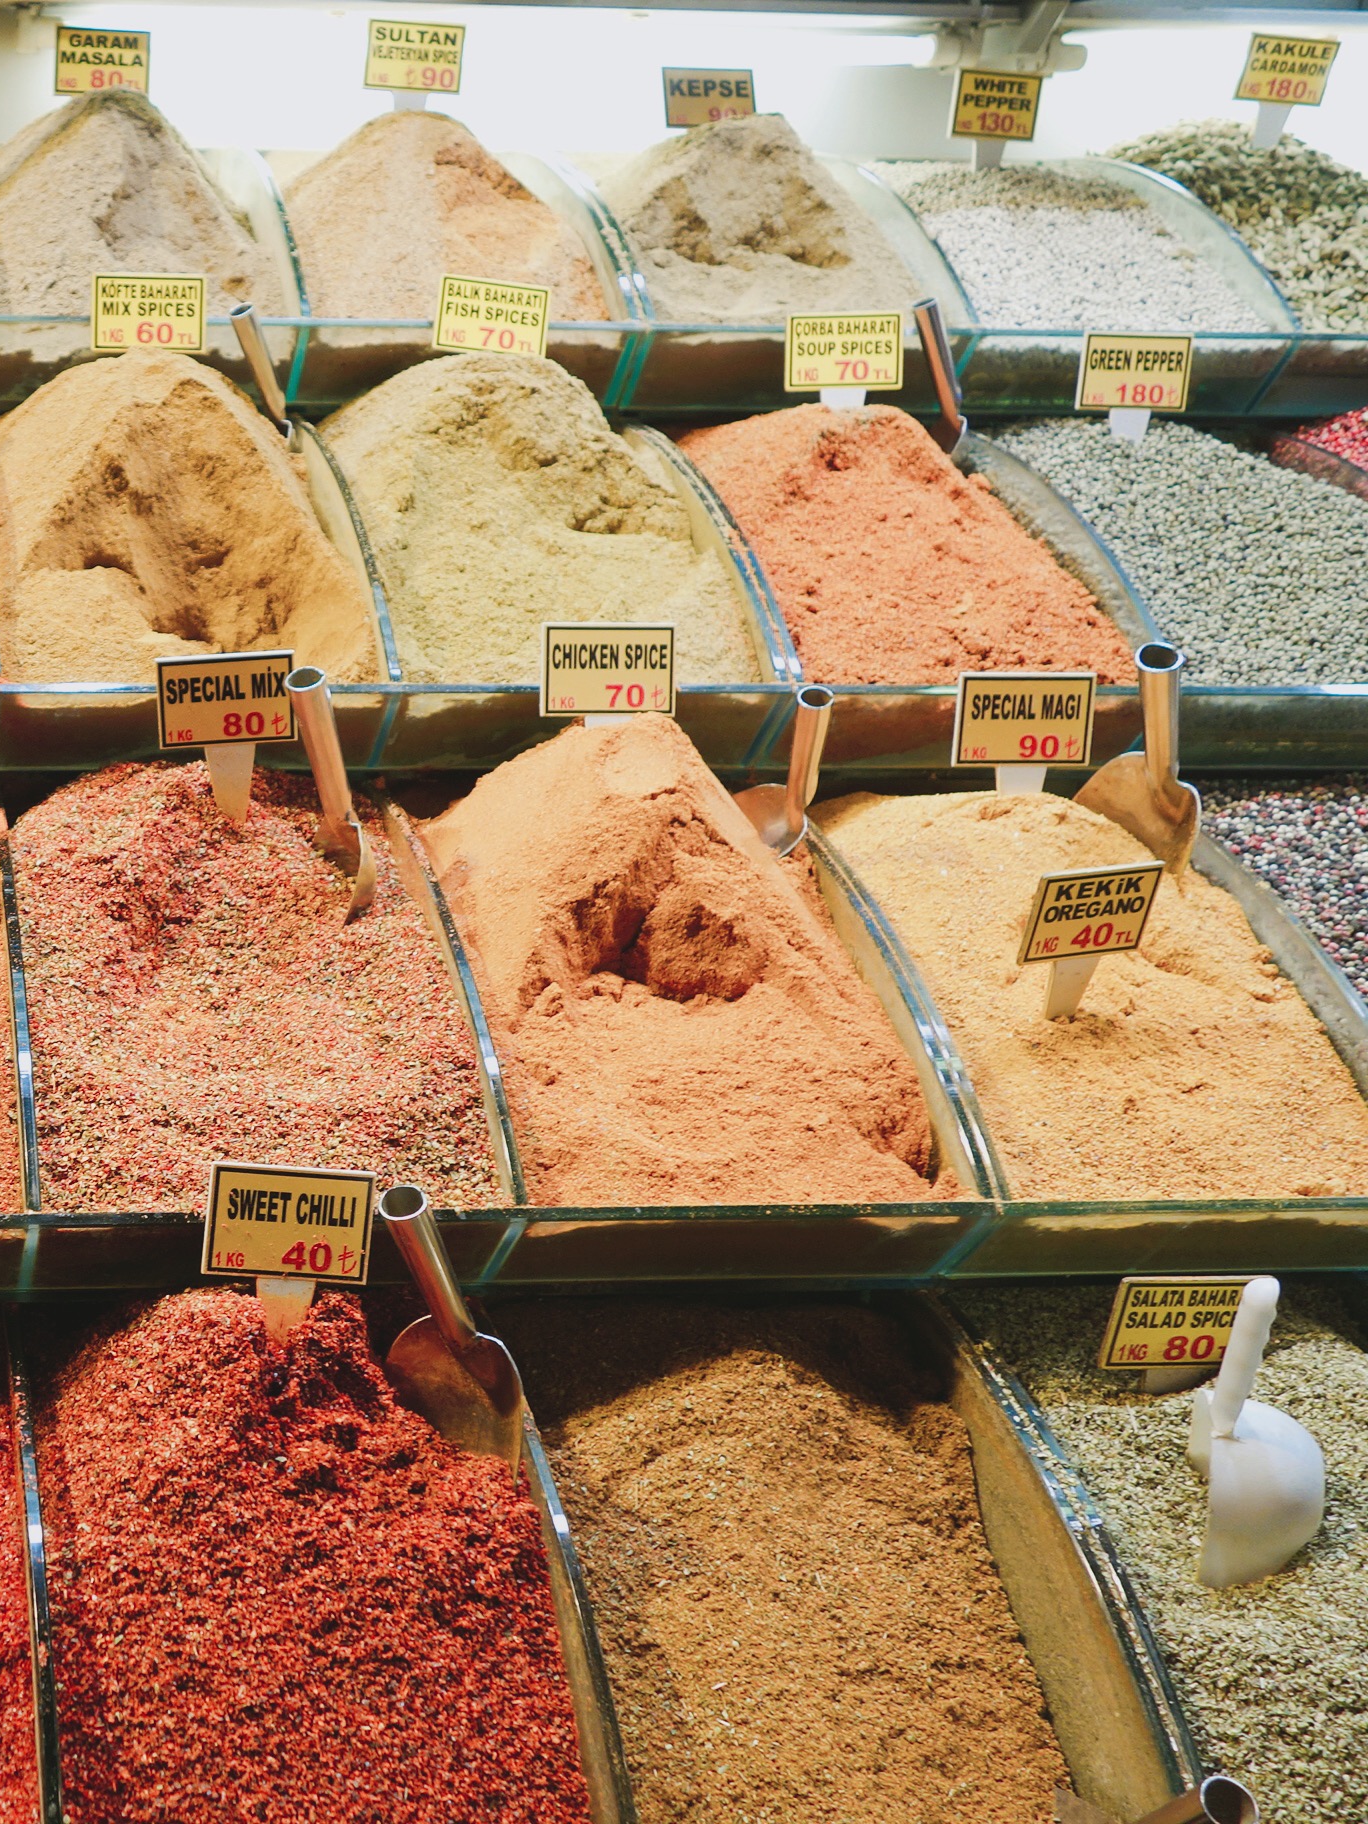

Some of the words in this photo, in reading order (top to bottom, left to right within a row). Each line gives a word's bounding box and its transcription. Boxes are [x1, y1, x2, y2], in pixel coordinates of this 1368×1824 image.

[69, 34, 138, 48] GARAM
[375, 27, 457, 46] SULTAN
[60, 51, 143, 67] MASALA
[432, 49, 459, 64] SPICE
[1256, 42, 1331, 60] KAKULE
[421, 67, 455, 88] 90
[1251, 59, 1328, 76] CARDAMON
[91, 70, 123, 88] 80
[669, 78, 750, 98] KEPSE
[974, 78, 1027, 94] WHITE
[1266, 78, 1307, 99] 180
[963, 95, 1030, 111] PEPPER
[979, 112, 1014, 133] 130
[140, 285, 198, 299] BAHARATI
[448, 282, 481, 300] BALIK
[484, 287, 542, 308] BAHARATI
[102, 301, 131, 316] MIX
[138, 302, 195, 317] SPICES
[445, 302, 480, 319] FISH
[485, 307, 539, 327] SPICES
[137, 321, 173, 344] 60
[177, 333, 196, 345] TL
[795, 323, 834, 338] ÇORBA
[838, 320, 897, 335] BAHARATI
[479, 327, 515, 348] 70
[518, 340, 535, 353] TL
[797, 340, 836, 356] SOUP
[841, 338, 892, 354] SPICES
[834, 360, 869, 380] 70
[874, 369, 893, 379] TL
[1090, 349, 1131, 371] GREEN
[1136, 350, 1183, 372] PEPPER
[1116, 384, 1163, 404] 180
[552, 644, 620, 670] CHICKEN
[624, 645, 667, 670] SPICE
[166, 676, 246, 704] SPECIAL
[560, 696, 575, 709] KG
[605, 684, 645, 707] 70
[972, 694, 1036, 720] SPECIAL
[1041, 694, 1080, 720] MAGI
[177, 729, 193, 741] KG
[223, 712, 265, 737] 80
[972, 746, 987, 759] KG
[1019, 734, 1059, 758] 90
[1043, 897, 1144, 923] OREGANO
[1071, 924, 1113, 948] 40
[1115, 930, 1134, 944] TL
[227, 1188, 291, 1224] SWEET
[296, 1193, 357, 1228] CHILLI
[226, 1253, 244, 1268] KG
[282, 1241, 331, 1273] 40
[1131, 1290, 1185, 1307] SALATA
[1188, 1290, 1240, 1307] BAHAR
[1125, 1311, 1187, 1329] SALAD
[1163, 1335, 1215, 1361] 80
